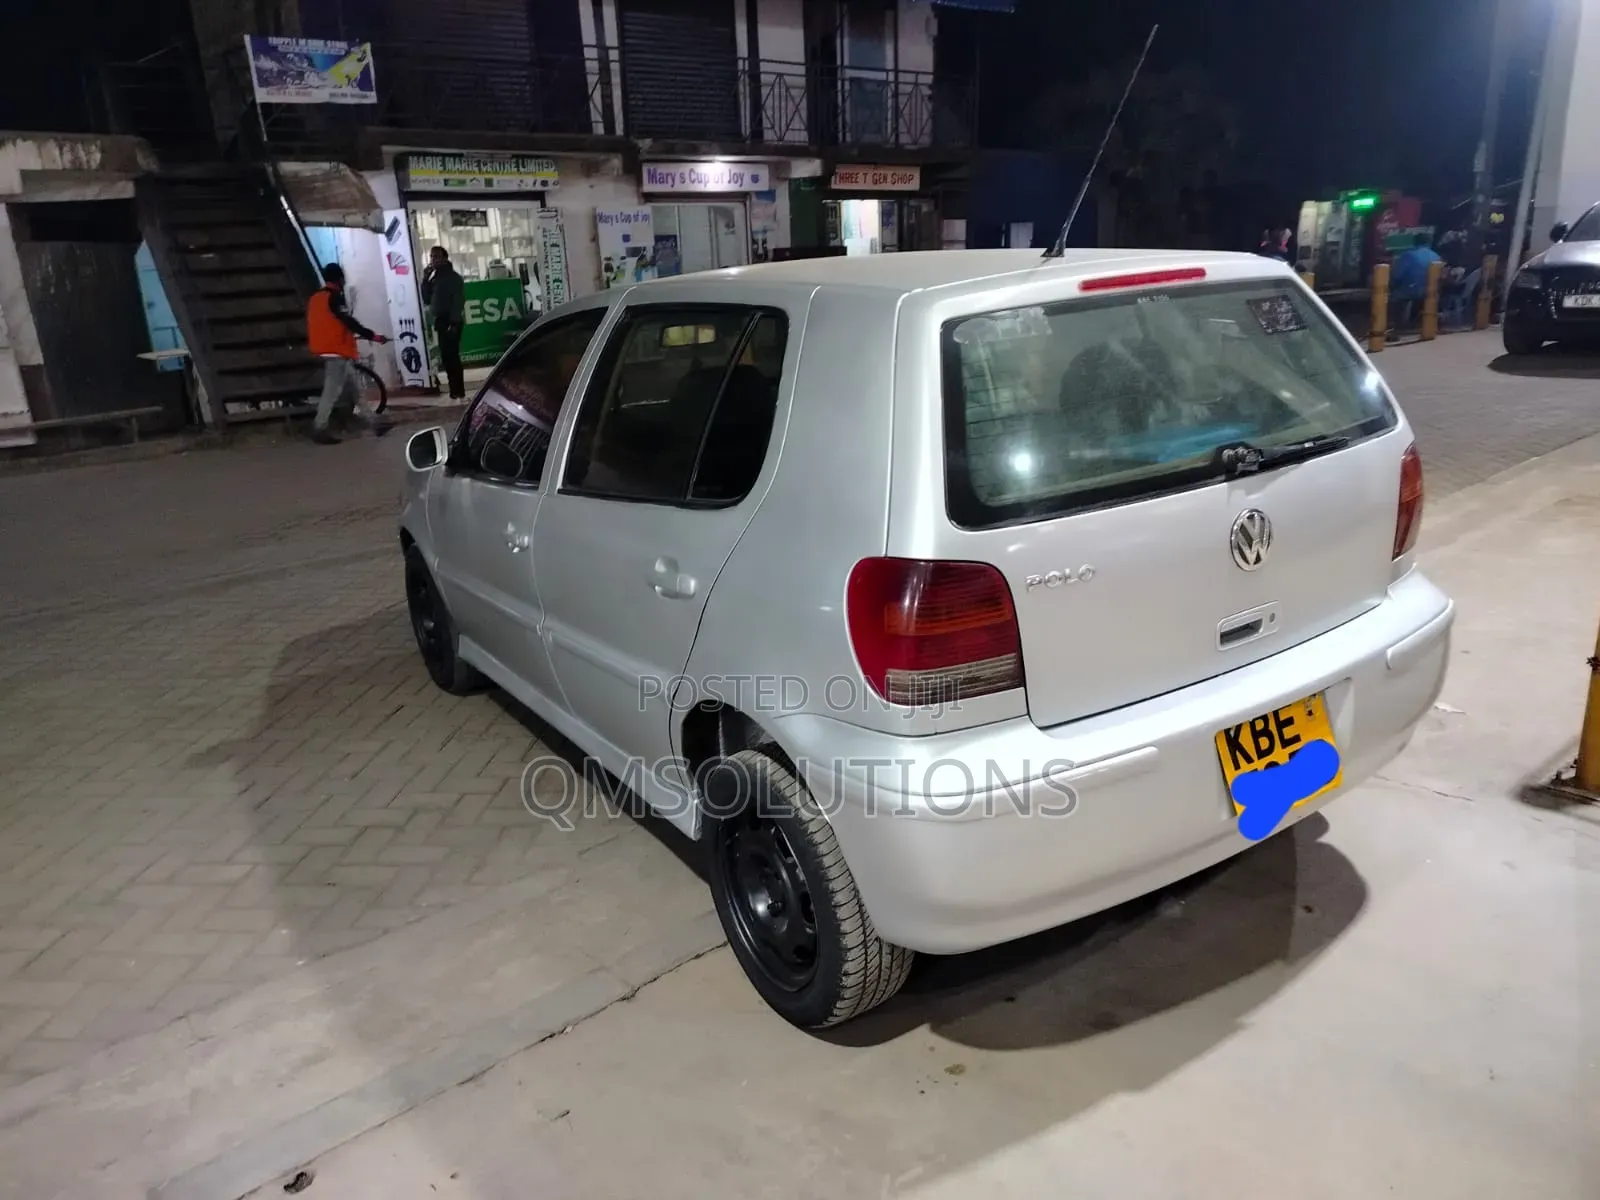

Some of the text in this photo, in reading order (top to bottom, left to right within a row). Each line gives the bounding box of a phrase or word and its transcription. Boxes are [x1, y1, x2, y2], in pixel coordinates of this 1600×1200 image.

[408, 155, 443, 170] MARIE
[445, 156, 479, 171] MARIE
[480, 157, 517, 172] CENTRE
[647, 167, 676, 188] Mary
[688, 168, 710, 187] Cup
[713, 170, 725, 184] of
[728, 168, 745, 188] Joy
[834, 172, 914, 185] THREE T GEN SHOP
[597, 211, 614, 226] Mary
[619, 211, 632, 224] Cup
[550, 246, 562, 280] MARIE
[1024, 562, 1096, 592] POLO
[1223, 704, 1302, 771] KBE
